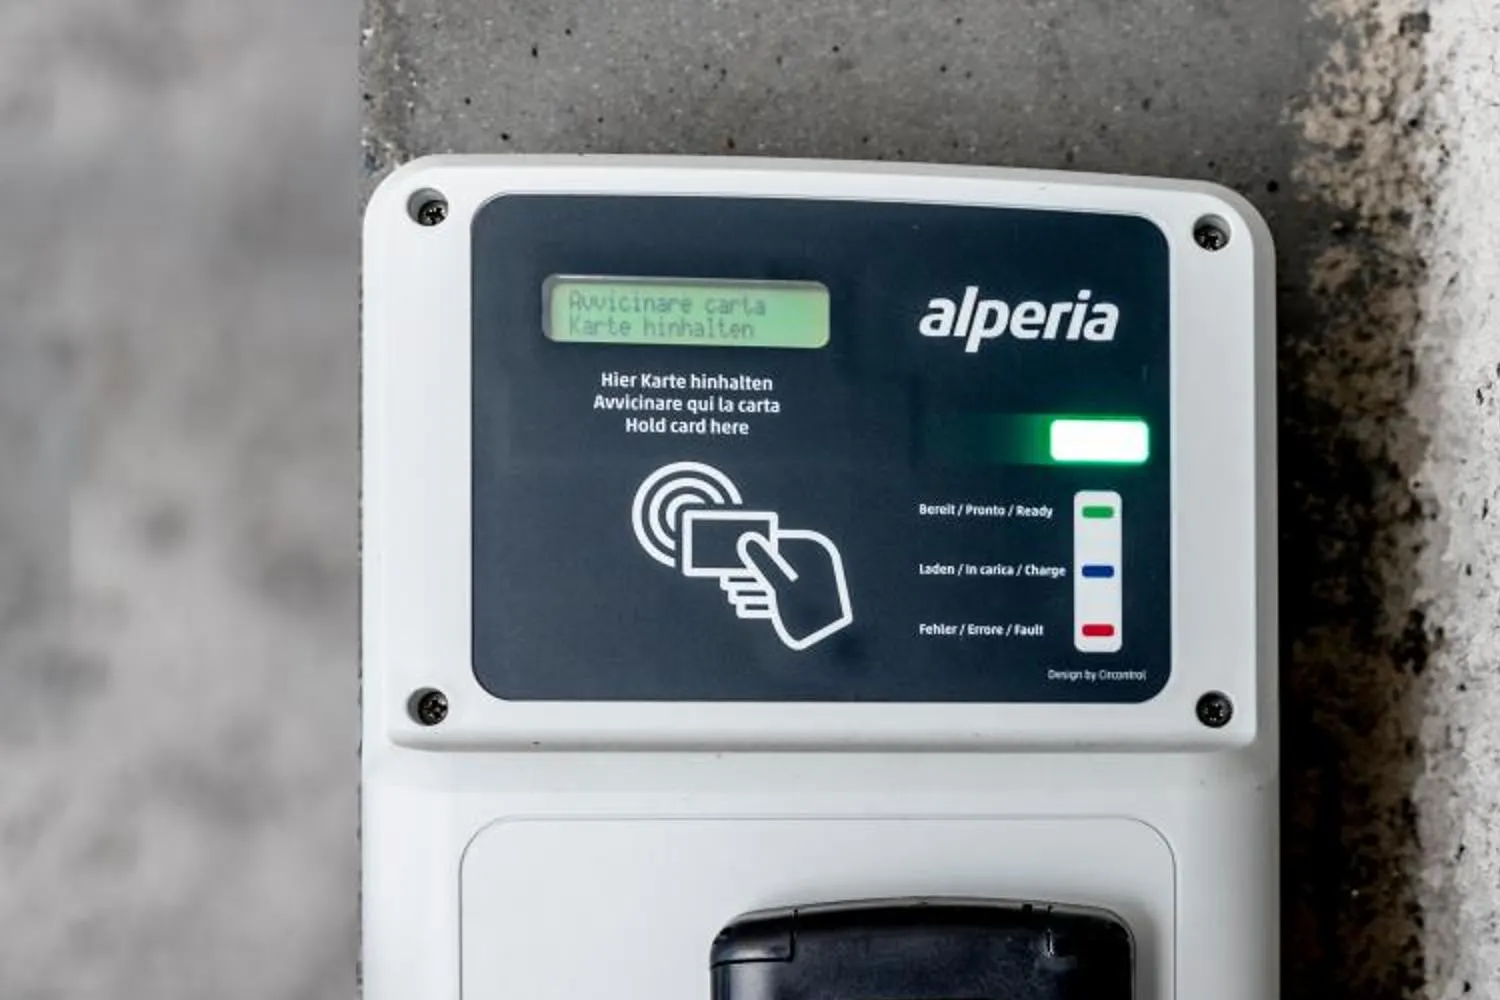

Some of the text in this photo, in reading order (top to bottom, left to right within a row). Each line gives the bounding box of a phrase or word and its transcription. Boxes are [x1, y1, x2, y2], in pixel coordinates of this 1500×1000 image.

[569, 289, 767, 316] Avvicinare carta
[569, 314, 755, 339] Karte hinhalten
[919, 285, 1120, 353] alperia
[601, 372, 773, 391] Hier Karte hinhalten
[593, 394, 780, 415] Avvicinare qui la carta
[625, 417, 750, 435] Hold card here
[919, 503, 955, 516] Bereit
[966, 504, 1005, 516] Pronto
[1016, 505, 1053, 519] Ready
[919, 563, 955, 575] Laden
[966, 564, 977, 575] In
[979, 564, 1014, 576] carica
[1024, 564, 1067, 578] Charge
[919, 623, 957, 635] Fehler
[968, 624, 1004, 636] Errore
[1014, 624, 1044, 636] Fault
[1047, 669, 1083, 682] Design
[1084, 669, 1097, 683] by
